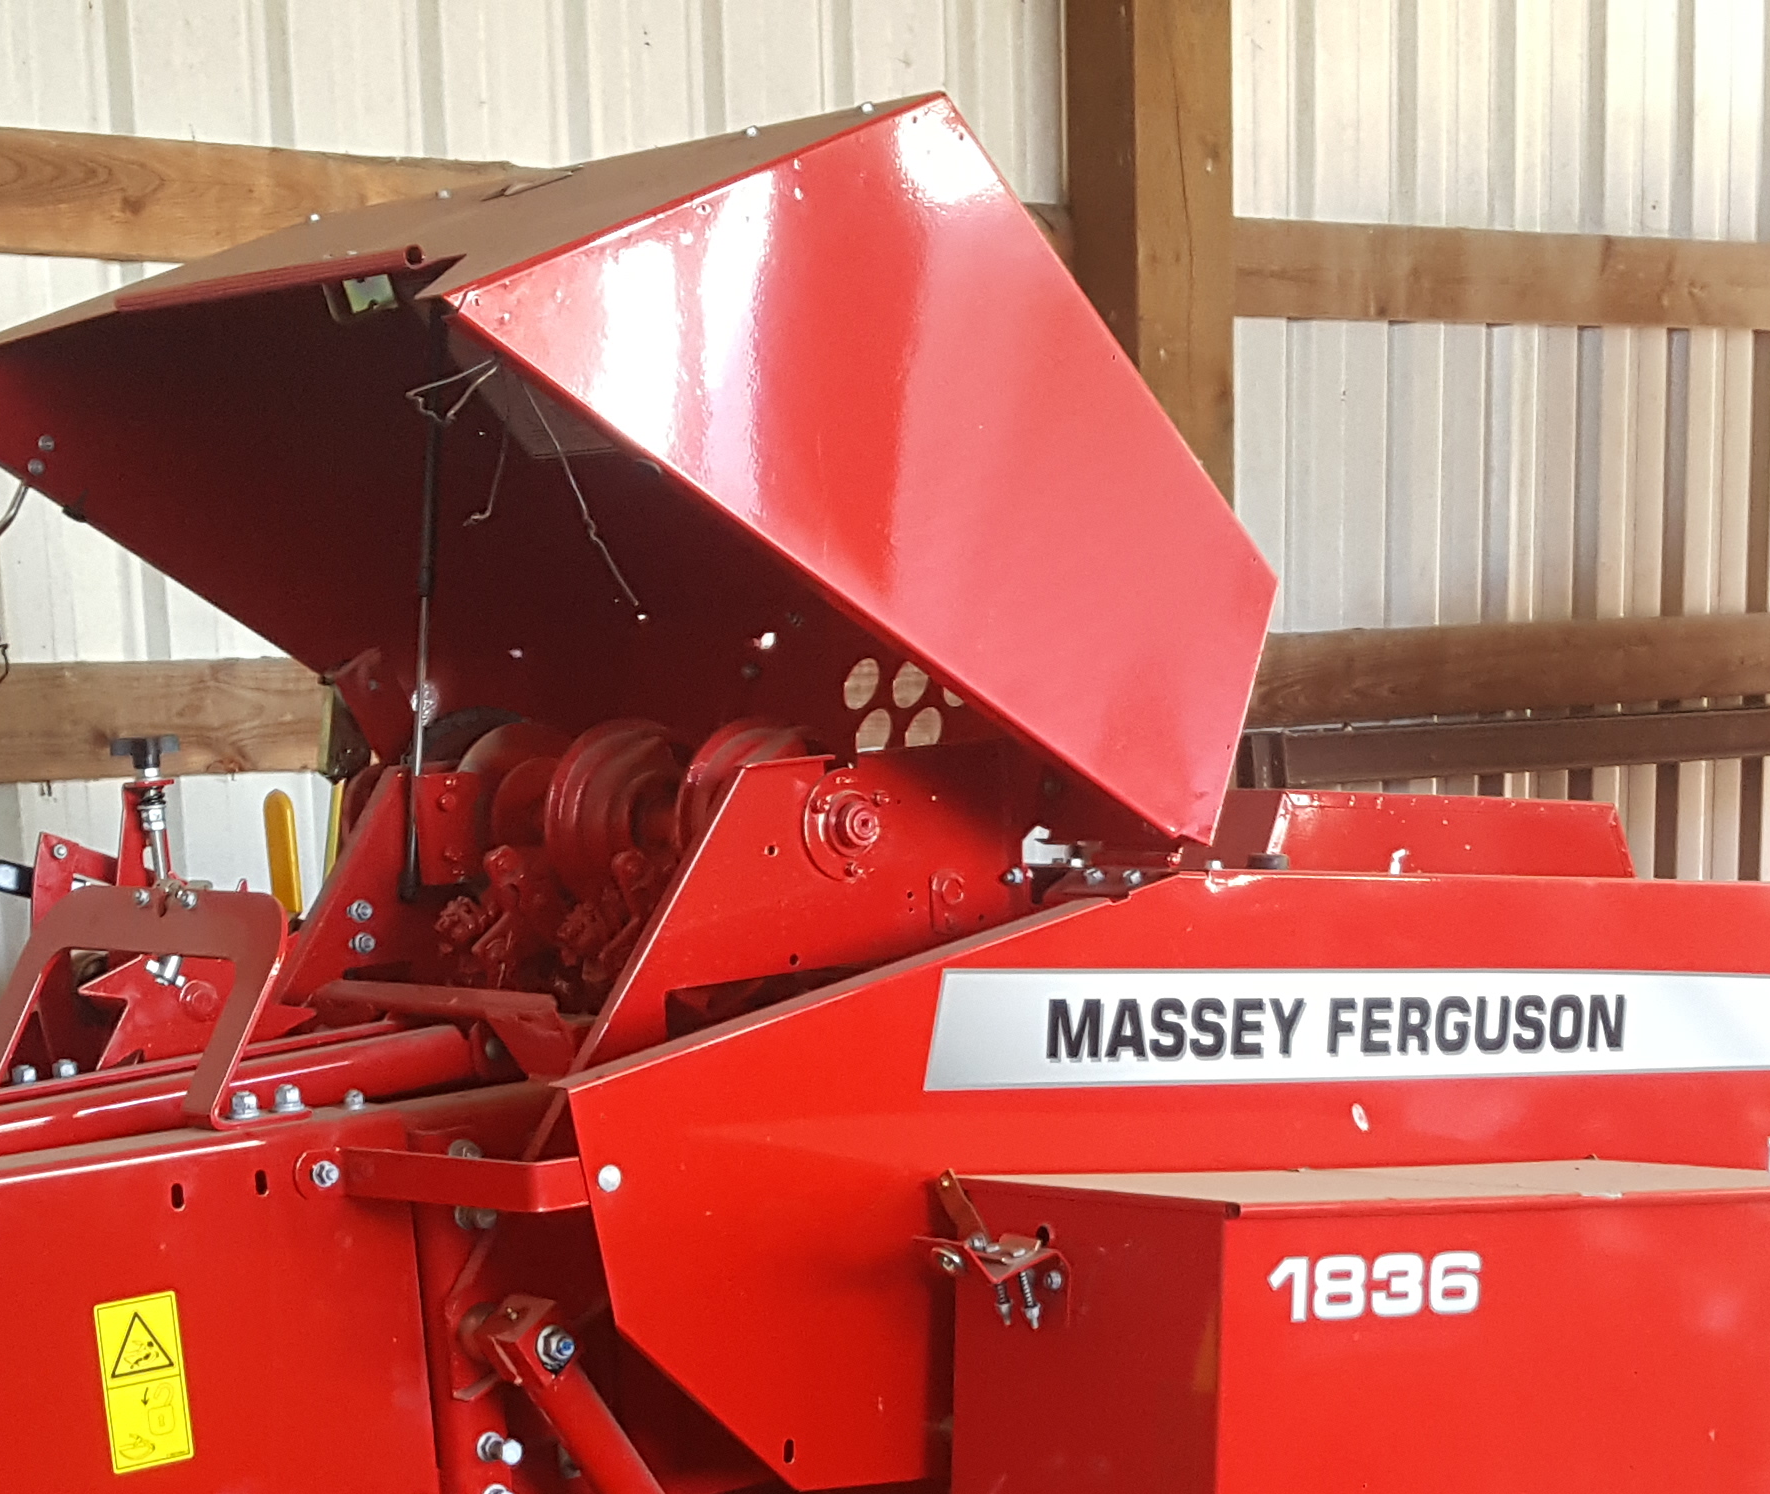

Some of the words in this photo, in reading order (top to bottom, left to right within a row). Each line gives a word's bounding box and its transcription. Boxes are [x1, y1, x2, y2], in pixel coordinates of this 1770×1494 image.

[1045, 997, 1305, 1060] MASSEY
[1328, 995, 1625, 1055] FERGUSON
[1266, 1250, 1483, 1323] 1836
